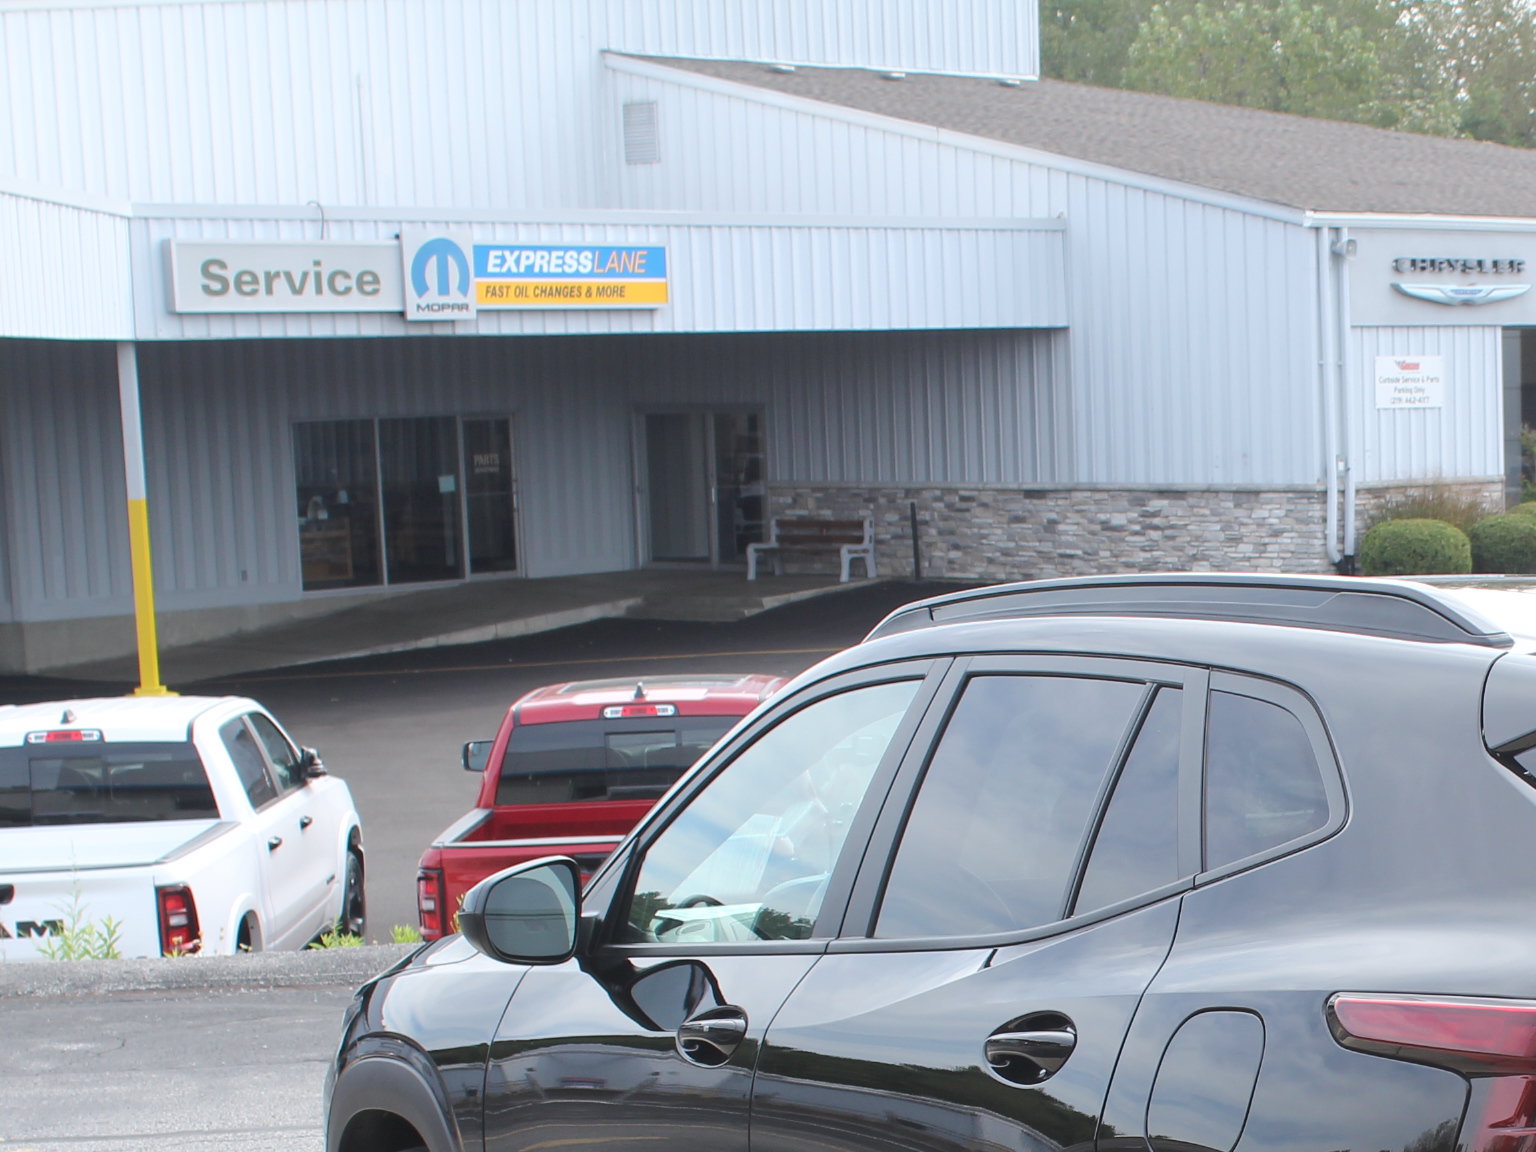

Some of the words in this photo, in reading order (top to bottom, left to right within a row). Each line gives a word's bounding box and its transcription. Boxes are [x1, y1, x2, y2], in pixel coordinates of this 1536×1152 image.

[1391, 257, 1526, 273] CHRYSLER
[200, 258, 382, 298] Service
[485, 285, 510, 298] FAST
[514, 285, 530, 298] OIL
[533, 285, 582, 298] CHANGES
[585, 285, 593, 298] &
[595, 285, 626, 298] MORE
[416, 302, 469, 313] MOPAR
